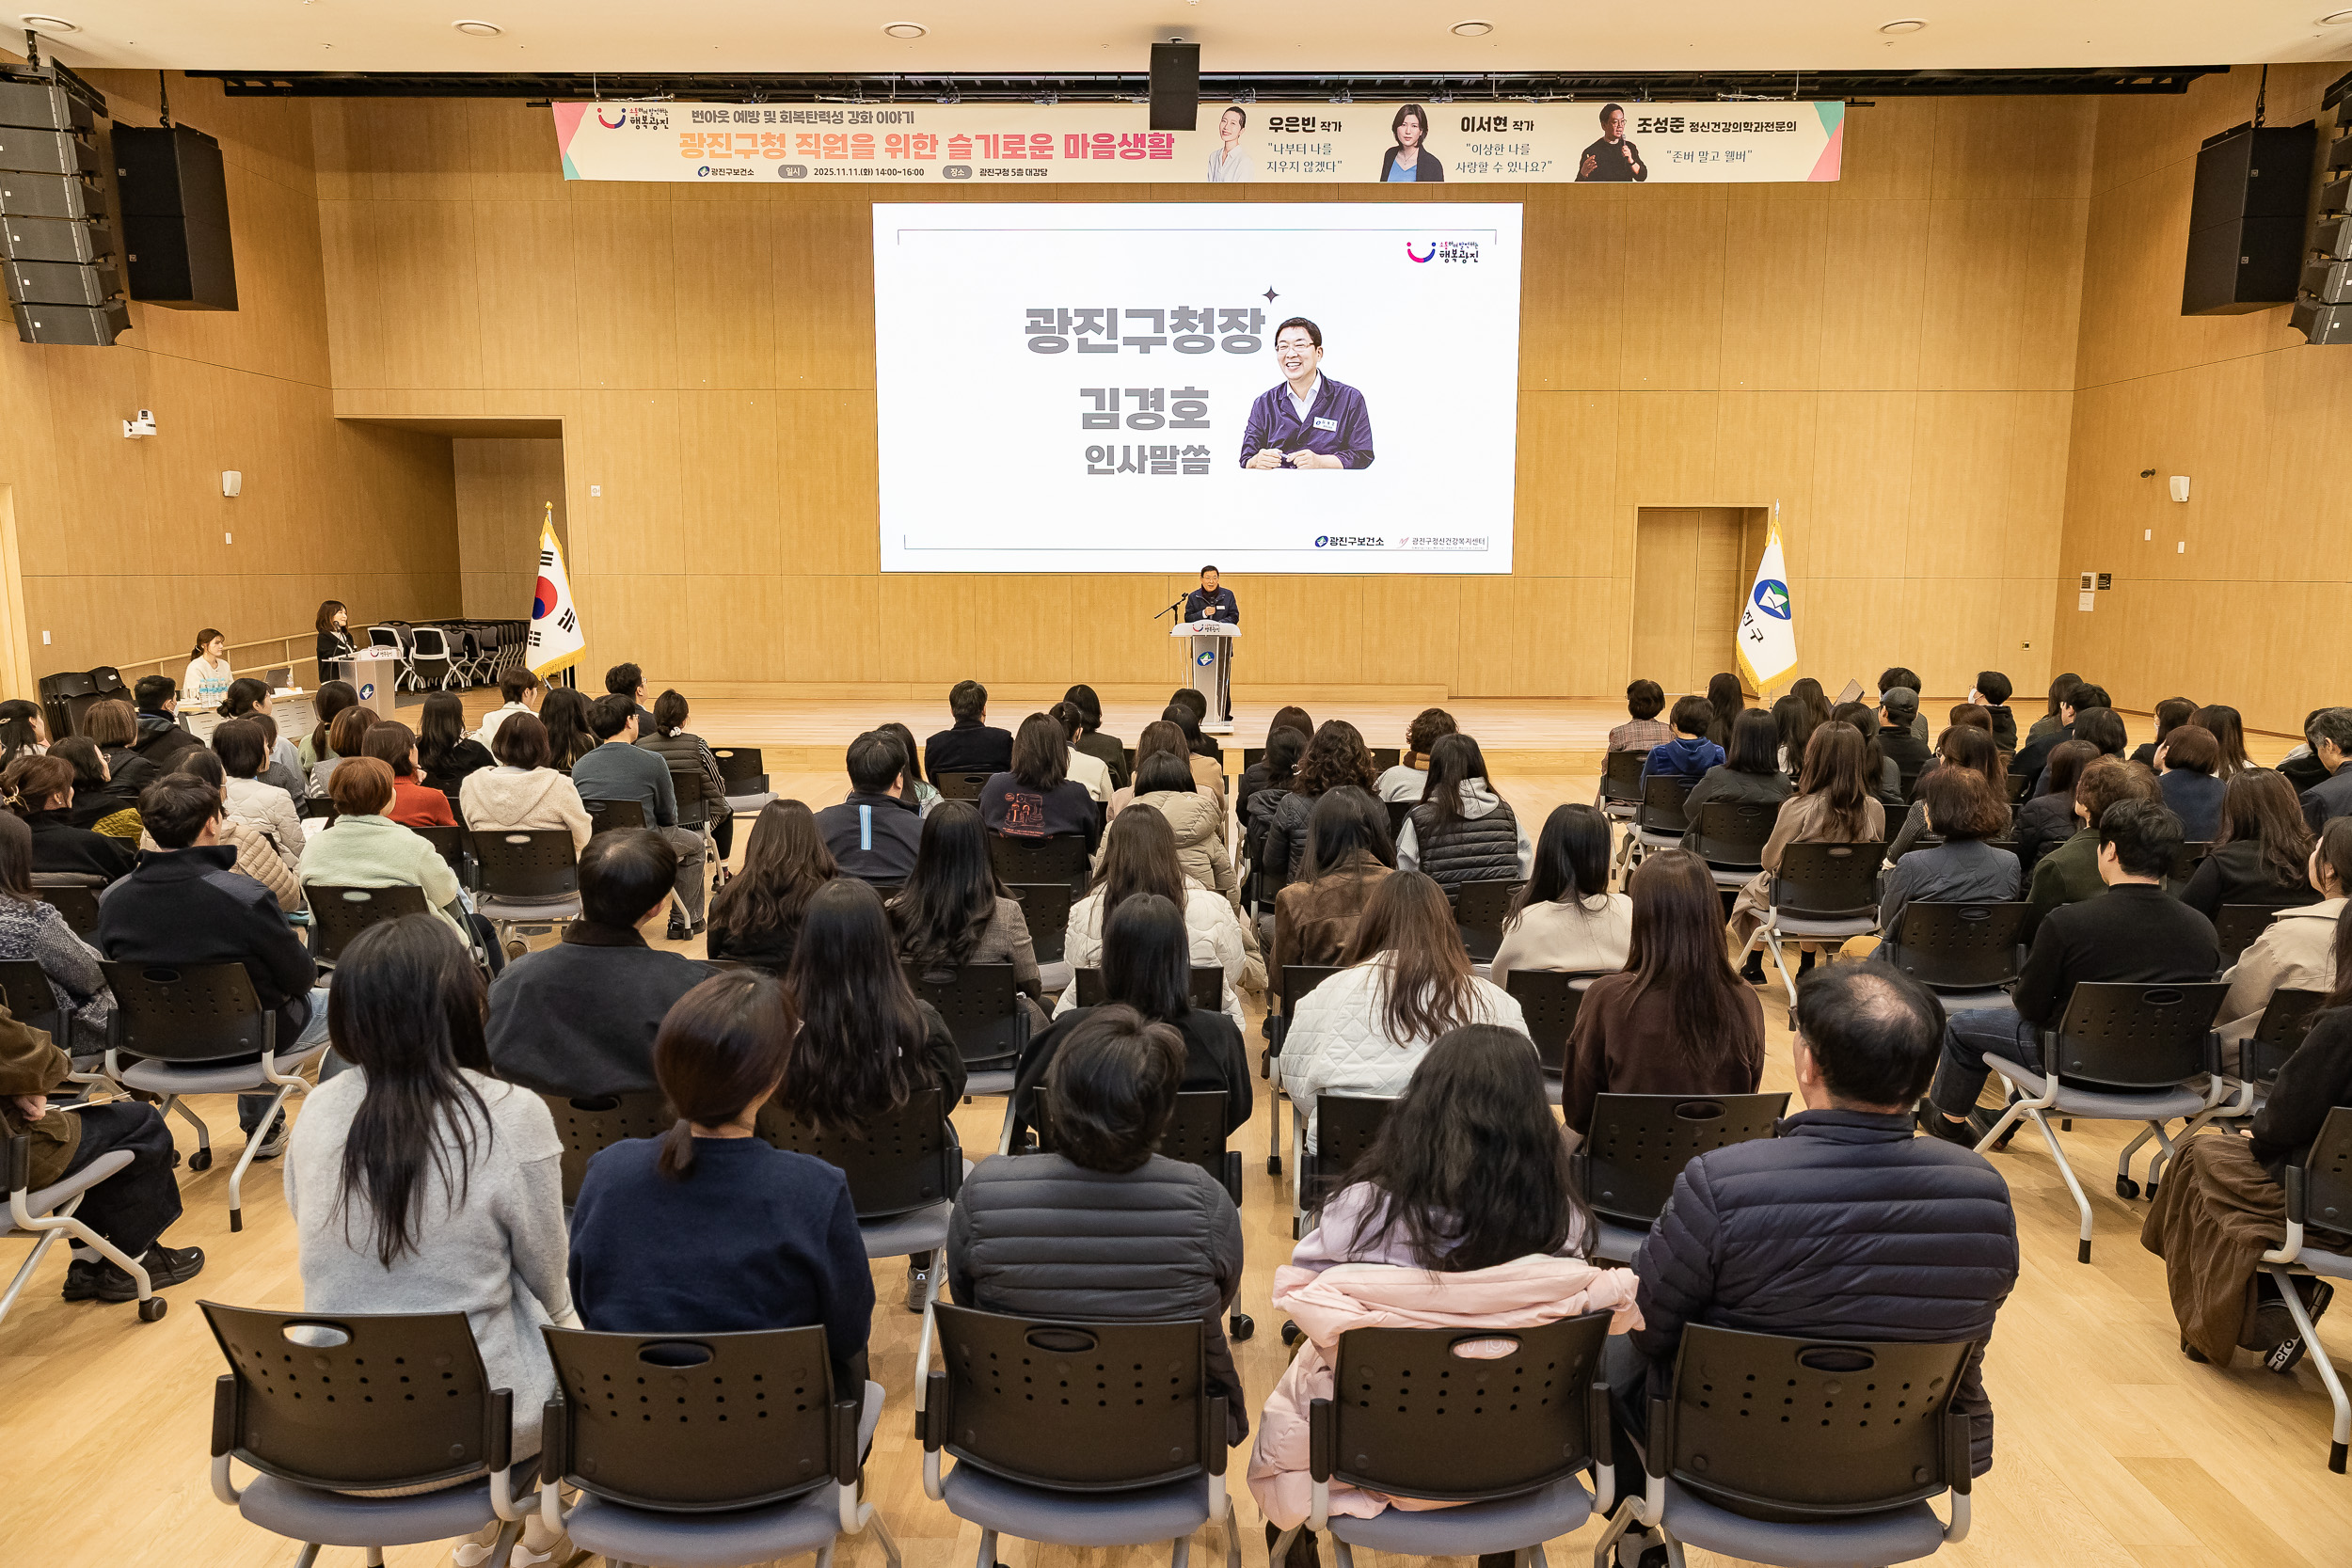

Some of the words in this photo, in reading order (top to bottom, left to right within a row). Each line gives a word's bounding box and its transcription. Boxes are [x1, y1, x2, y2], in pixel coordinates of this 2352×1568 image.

[629, 115, 669, 131] 행복광진
[691, 110, 729, 124] 번아웃
[733, 110, 760, 124] 예방
[764, 110, 776, 124] 및
[780, 110, 844, 124] 회복탄력성
[848, 110, 873, 124] 강화
[877, 110, 914, 124] 이야기
[1268, 116, 1316, 133] 우은빈
[1320, 120, 1343, 133] 작가
[1460, 116, 1508, 133] 이서현
[1512, 120, 1534, 132] 작가
[1637, 117, 1685, 134] 조성준
[1689, 120, 1797, 133] 정신건강의학과전문의
[678, 133, 787, 160] 광진구청
[795, 133, 876, 160] 직원을
[884, 133, 939, 160] 위한
[947, 133, 1055, 160] 슬기로운
[1064, 133, 1175, 160] 마음생활
[1268, 143, 1307, 155] "나부터
[1311, 143, 1333, 155] 나를
[1466, 143, 1505, 155] "이상한
[1508, 143, 1531, 155] 나를
[1666, 150, 1694, 163] "존버
[1698, 150, 1721, 163] 말고
[710, 167, 755, 177] 광진구보건소
[786, 166, 801, 177] 일시
[814, 167, 874, 177] 2025.11.11.(화)
[875, 168, 925, 177] 14:00~16:00
[950, 167, 965, 177] 장소
[978, 167, 1009, 177] 광진구청
[1011, 167, 1024, 177] 5층
[1025, 167, 1048, 177] 대강당
[1266, 161, 1299, 173] 지우지
[1303, 161, 1343, 173] 않겠다"
[1454, 161, 1489, 174] 사랑할
[1492, 161, 1503, 173] 수
[1507, 160, 1552, 174] 있나요?"
[1438, 248, 1479, 263] 행복광진
[1025, 306, 1265, 355] 광진구청장
[1079, 387, 1211, 431] 김경호
[1085, 445, 1211, 475] 인사말씀
[1329, 536, 1385, 546] 광진구보건소
[1743, 610, 1764, 642] 진구
